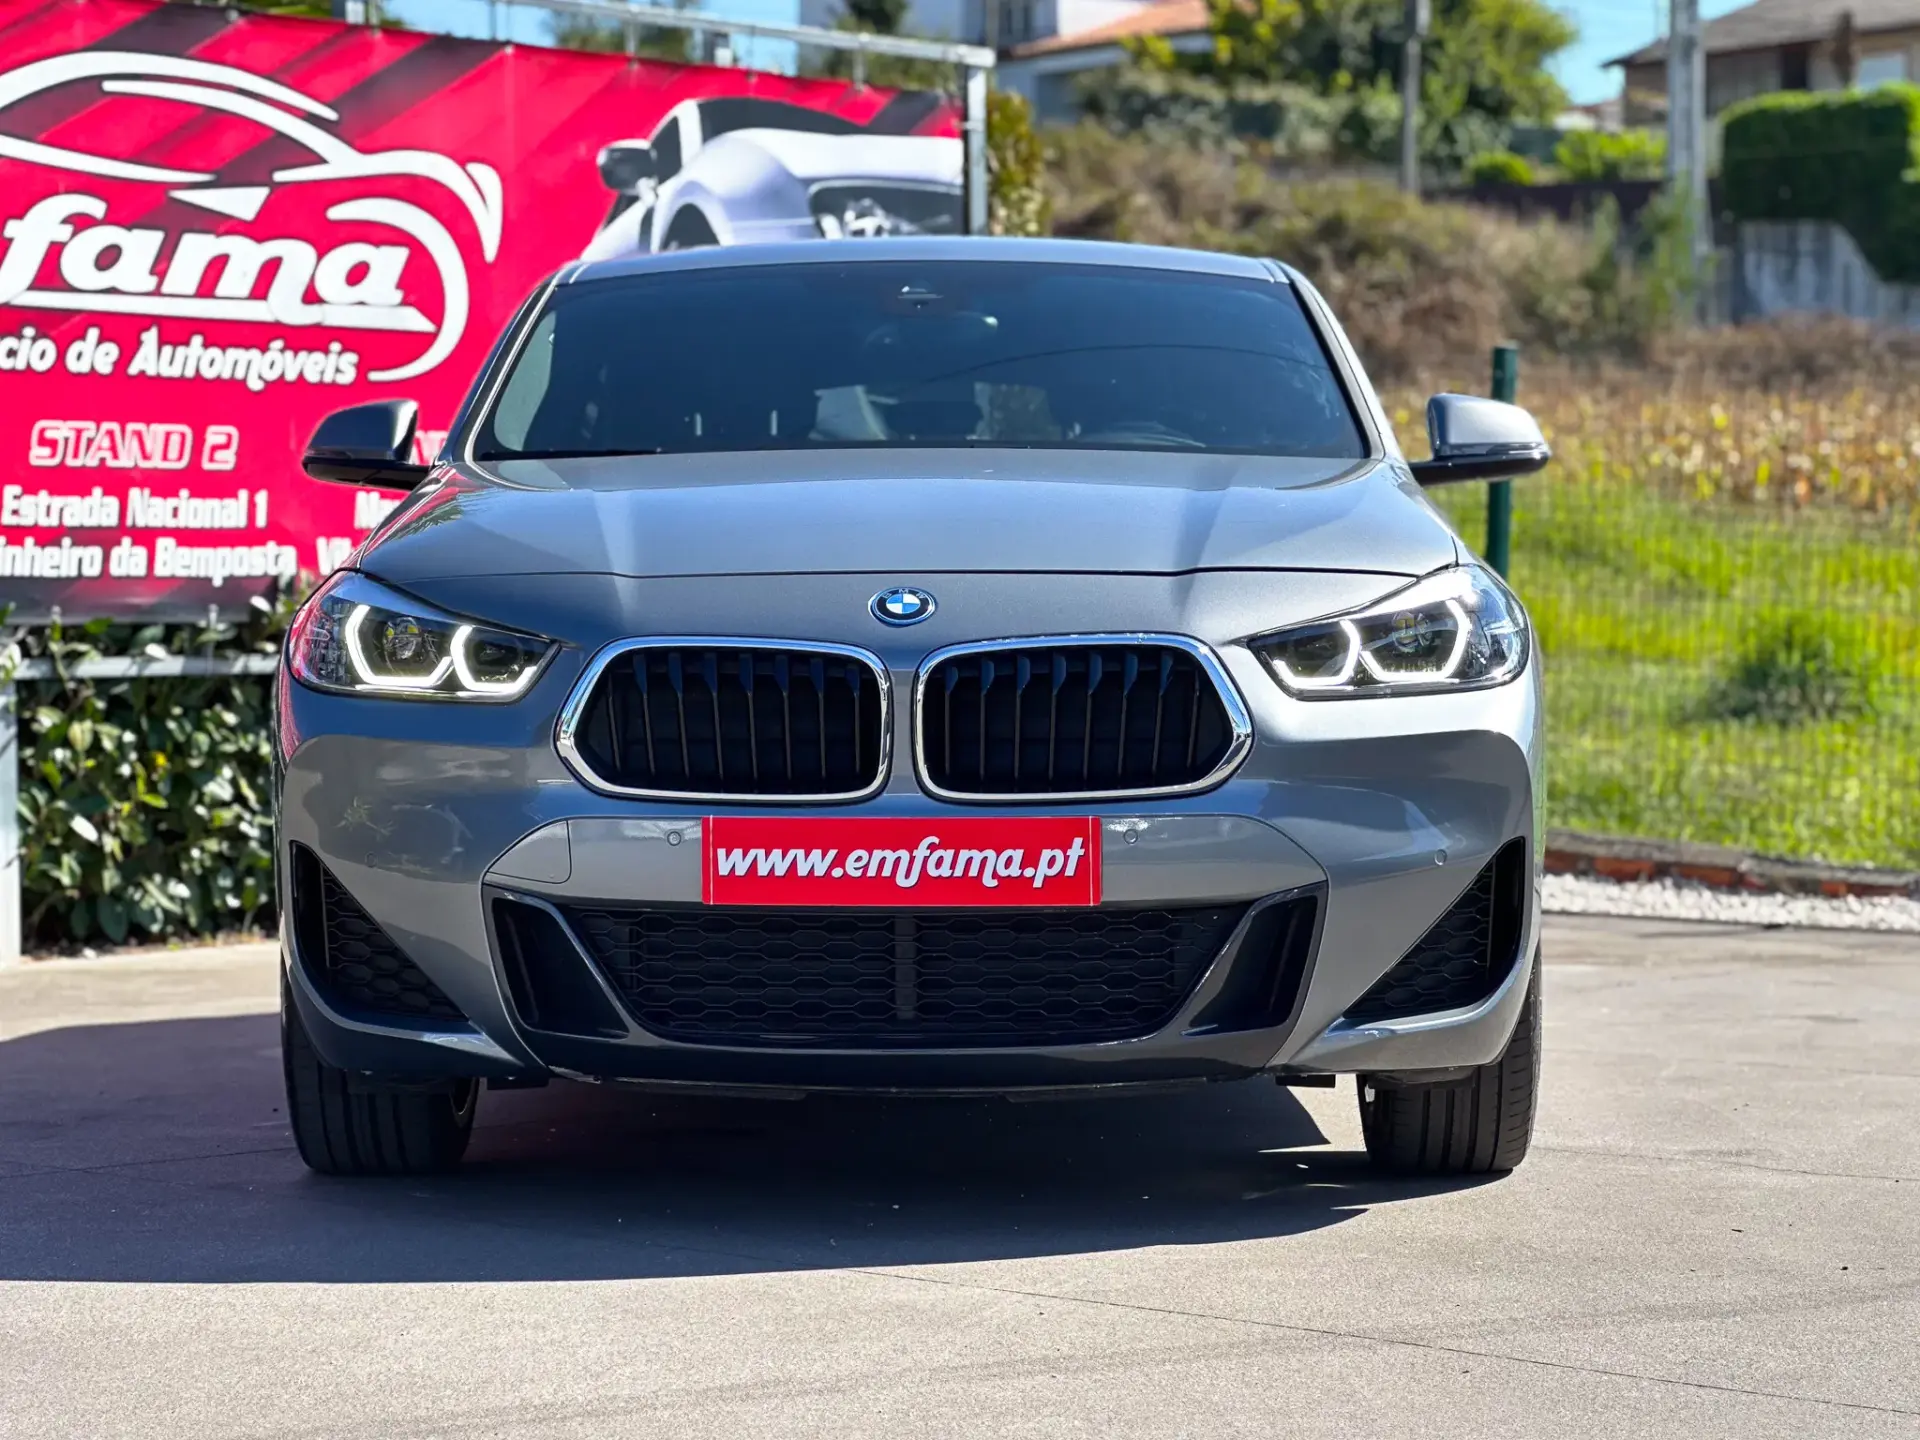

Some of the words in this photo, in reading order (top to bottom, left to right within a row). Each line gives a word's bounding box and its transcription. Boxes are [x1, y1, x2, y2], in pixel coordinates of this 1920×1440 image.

[65, 327, 120, 375] de
[127, 323, 360, 391] Automóveis
[29, 419, 193, 469] STAND
[201, 425, 240, 471] 2
[1, 485, 120, 527] Estrada
[126, 487, 249, 529] Nacional
[254, 489, 269, 529] 1
[109, 536, 148, 577] da
[154, 537, 297, 588] Bemposta
[716, 835, 1085, 888] www.emfama.pt
